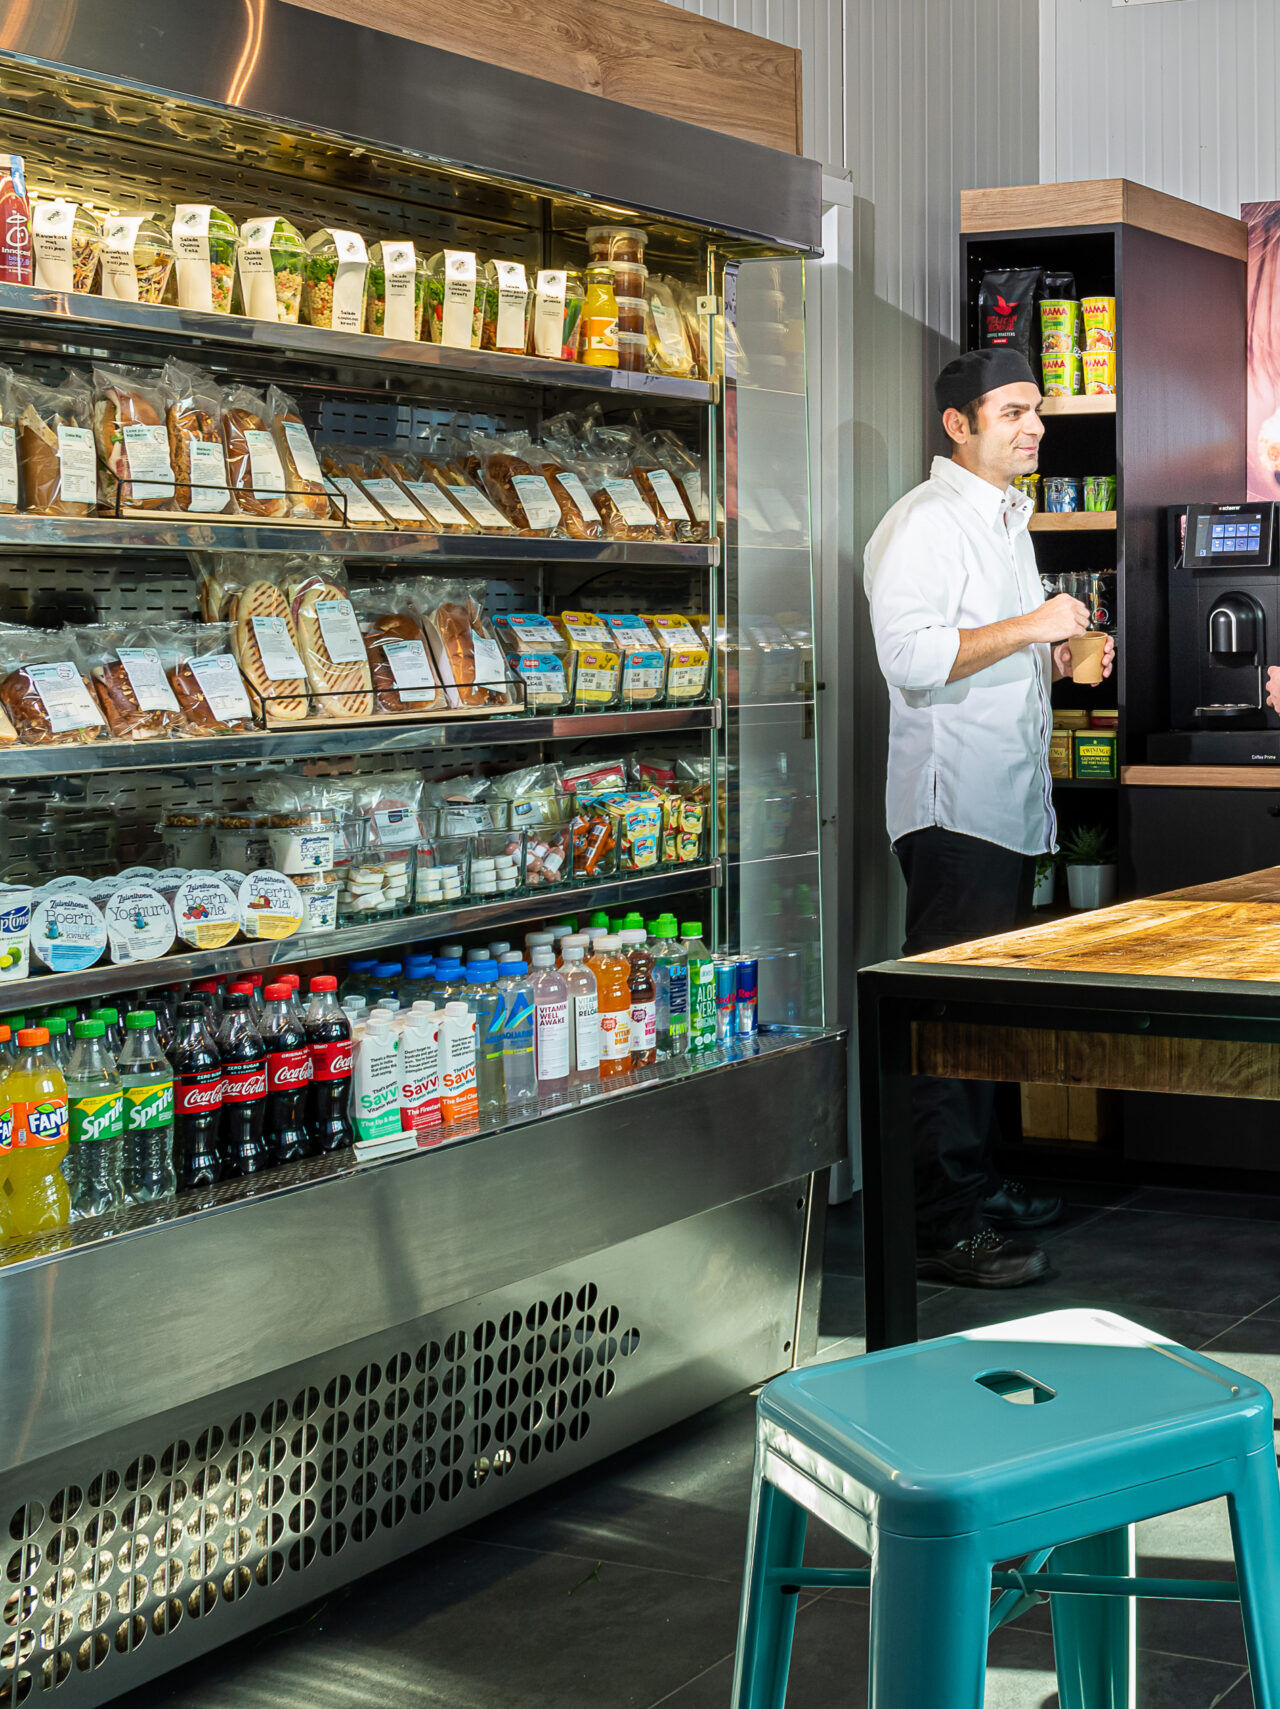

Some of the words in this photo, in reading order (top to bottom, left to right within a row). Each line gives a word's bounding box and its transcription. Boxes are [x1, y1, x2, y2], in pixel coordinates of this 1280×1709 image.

[1042, 307, 1068, 316] MAMA
[1084, 305, 1109, 314] MAMA
[1043, 360, 1067, 369] MAMA
[1085, 358, 1109, 367] MAMA
[108, 903, 170, 922] Yoghurt
[697, 984, 716, 1002] ALOE
[540, 1004, 567, 1013] VITAMIN
[696, 1003, 716, 1019] VERA
[539, 1017, 565, 1026] AWAKE
[443, 1066, 476, 1087] Savv
[402, 1075, 440, 1098] Savv
[360, 1086, 398, 1109] Savv
[27, 1105, 69, 1134] FANT
